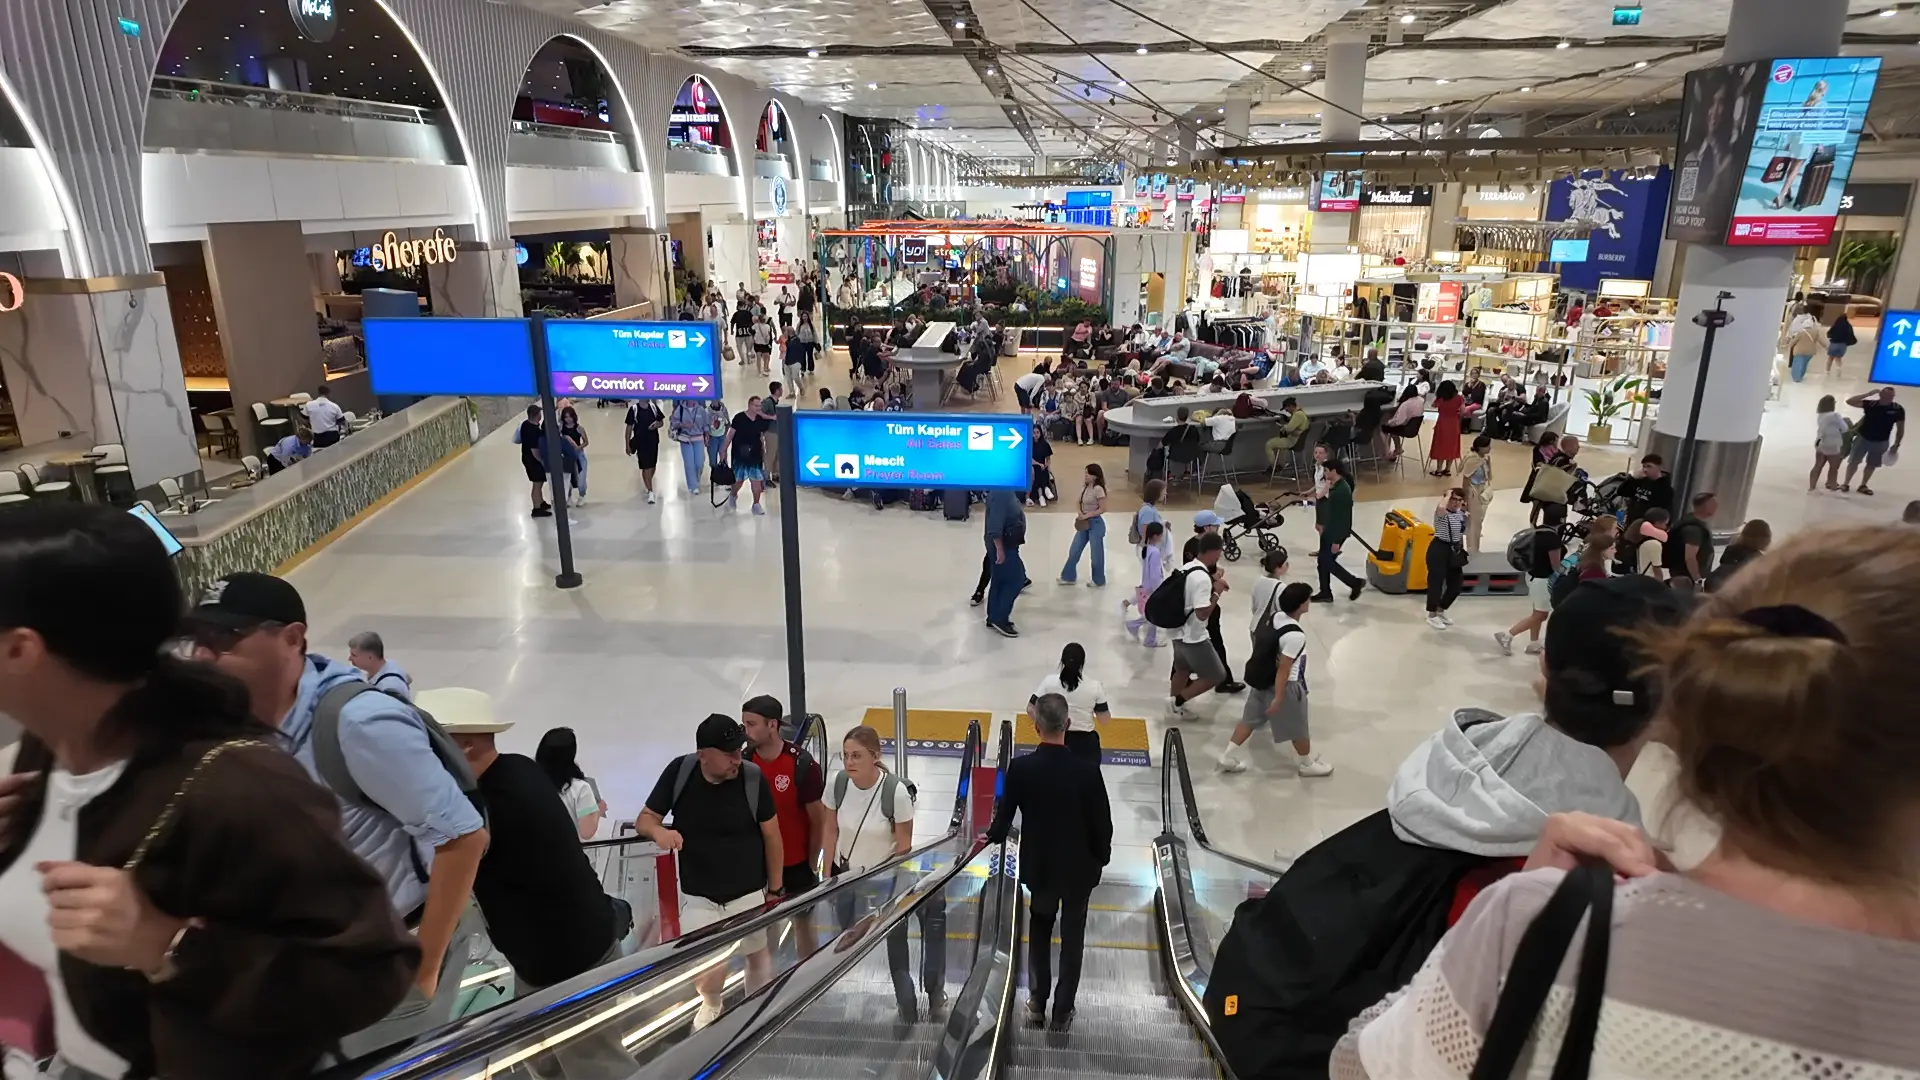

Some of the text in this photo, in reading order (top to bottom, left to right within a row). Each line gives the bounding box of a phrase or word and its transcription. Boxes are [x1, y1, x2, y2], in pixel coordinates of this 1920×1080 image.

[1688, 205, 1700, 215] CAN
[1676, 216, 1690, 225] HELP
[1690, 217, 1706, 227] YOU?
[372, 228, 457, 272] sherefe
[1598, 253, 1626, 262] BURBERRY
[612, 329, 633, 339] Tüm
[591, 378, 687, 393] Comfort Lounge
[886, 423, 962, 438] Tüm Kapılar
[906, 439, 962, 449] All Gates
[864, 454, 905, 466] Mescit
[864, 469, 944, 481] Prayer Room
